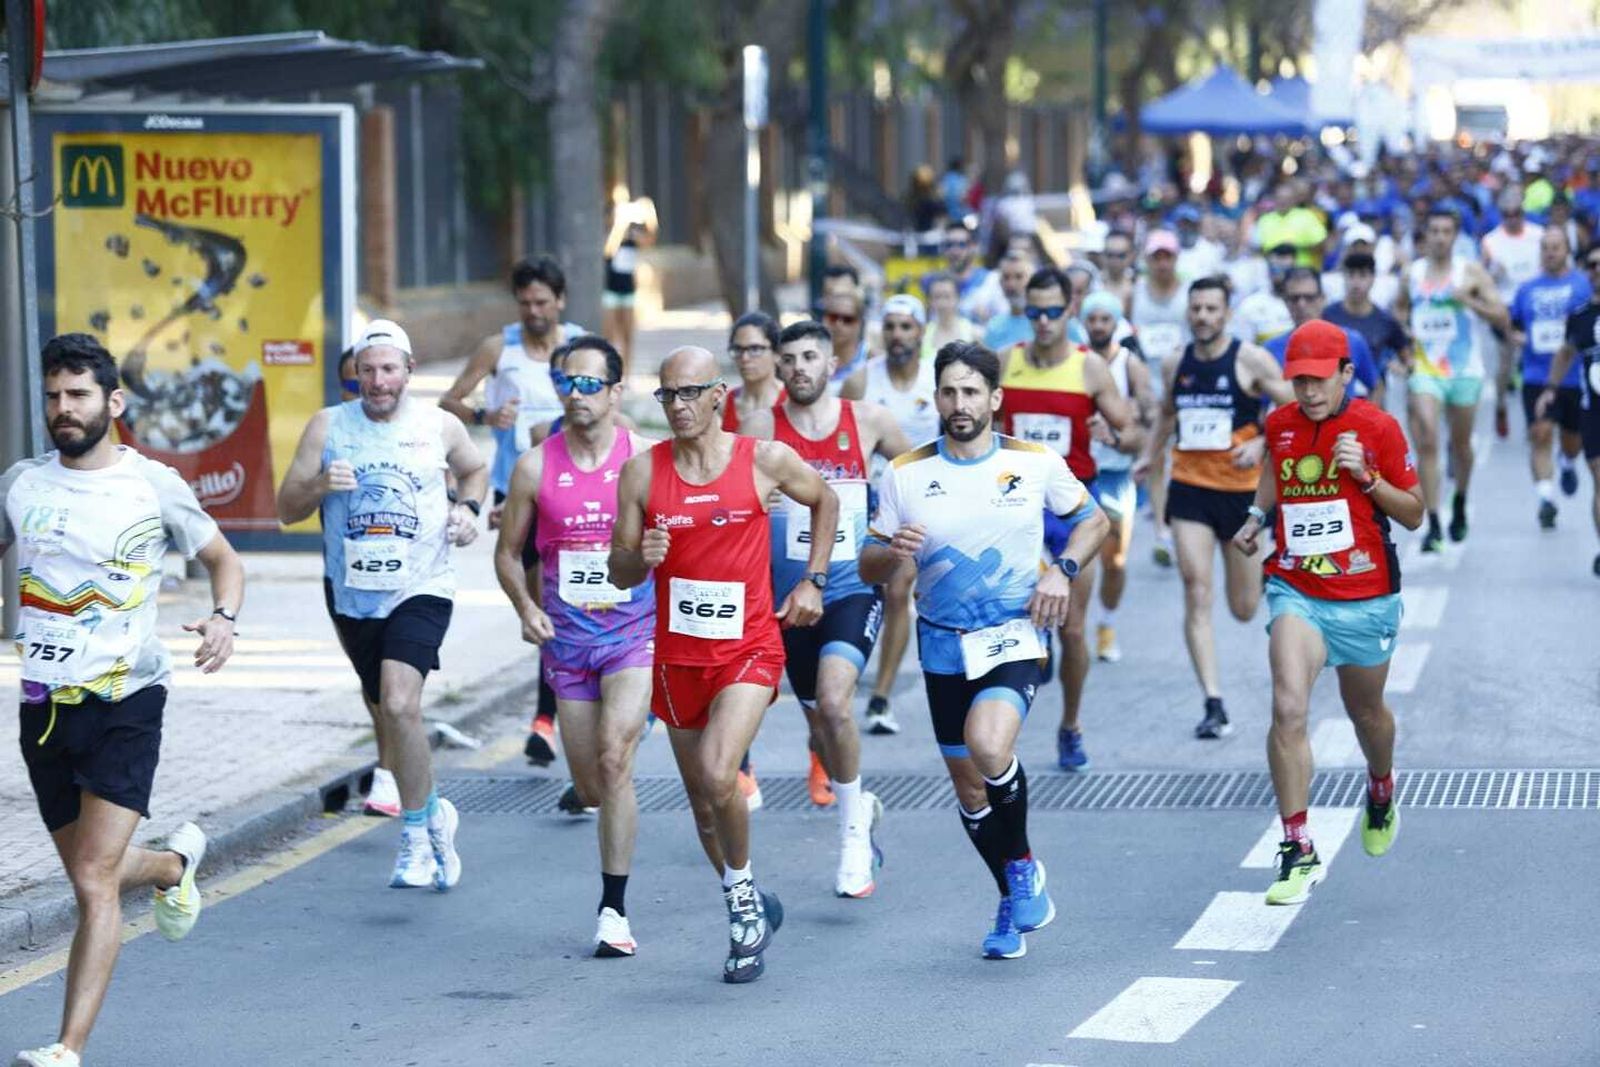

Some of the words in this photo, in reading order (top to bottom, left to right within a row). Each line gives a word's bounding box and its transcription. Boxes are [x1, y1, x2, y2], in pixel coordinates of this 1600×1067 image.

[134, 151, 252, 181] Nuevo
[136, 187, 302, 227] McFlurry
[563, 512, 617, 527] PAMP
[1292, 519, 1344, 537] 223
[350, 559, 402, 573] 429
[569, 570, 612, 585] 32
[678, 600, 737, 619] 662
[29, 641, 75, 663] 757
